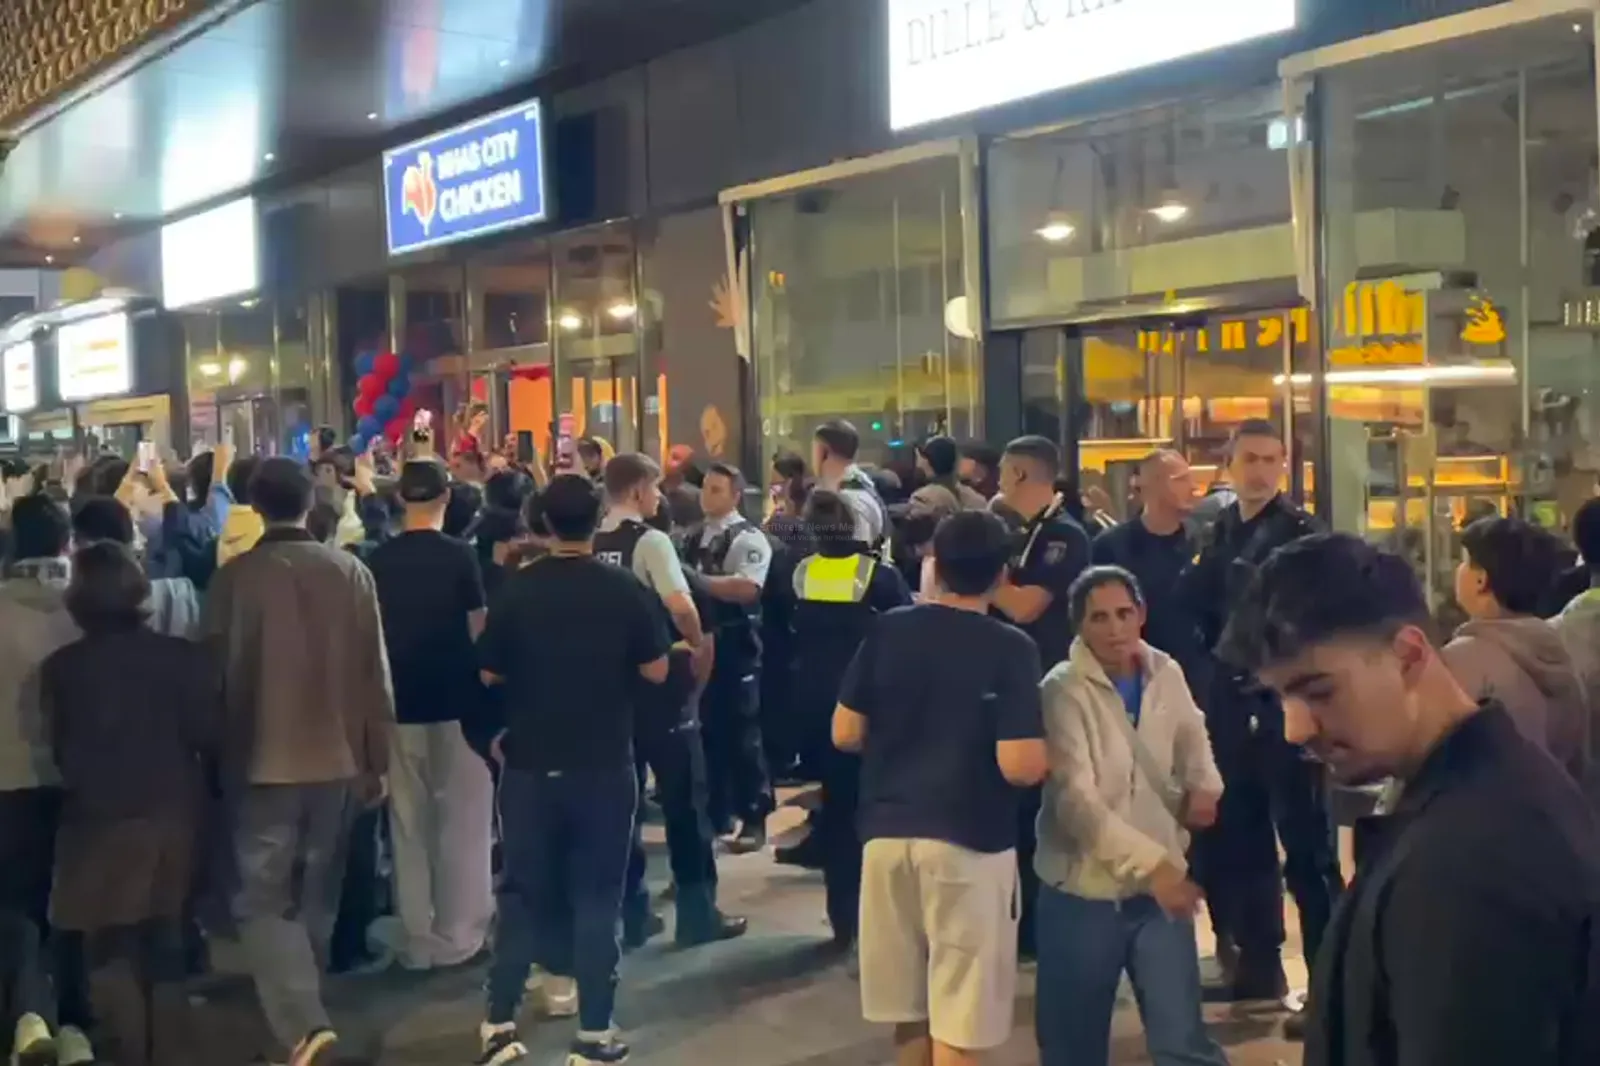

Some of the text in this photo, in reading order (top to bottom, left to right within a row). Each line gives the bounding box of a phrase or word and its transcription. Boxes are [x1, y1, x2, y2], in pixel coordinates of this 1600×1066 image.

[906, 0, 1051, 66] DILLE &
[481, 129, 518, 167] CITY
[439, 168, 523, 223] CHICKEN
